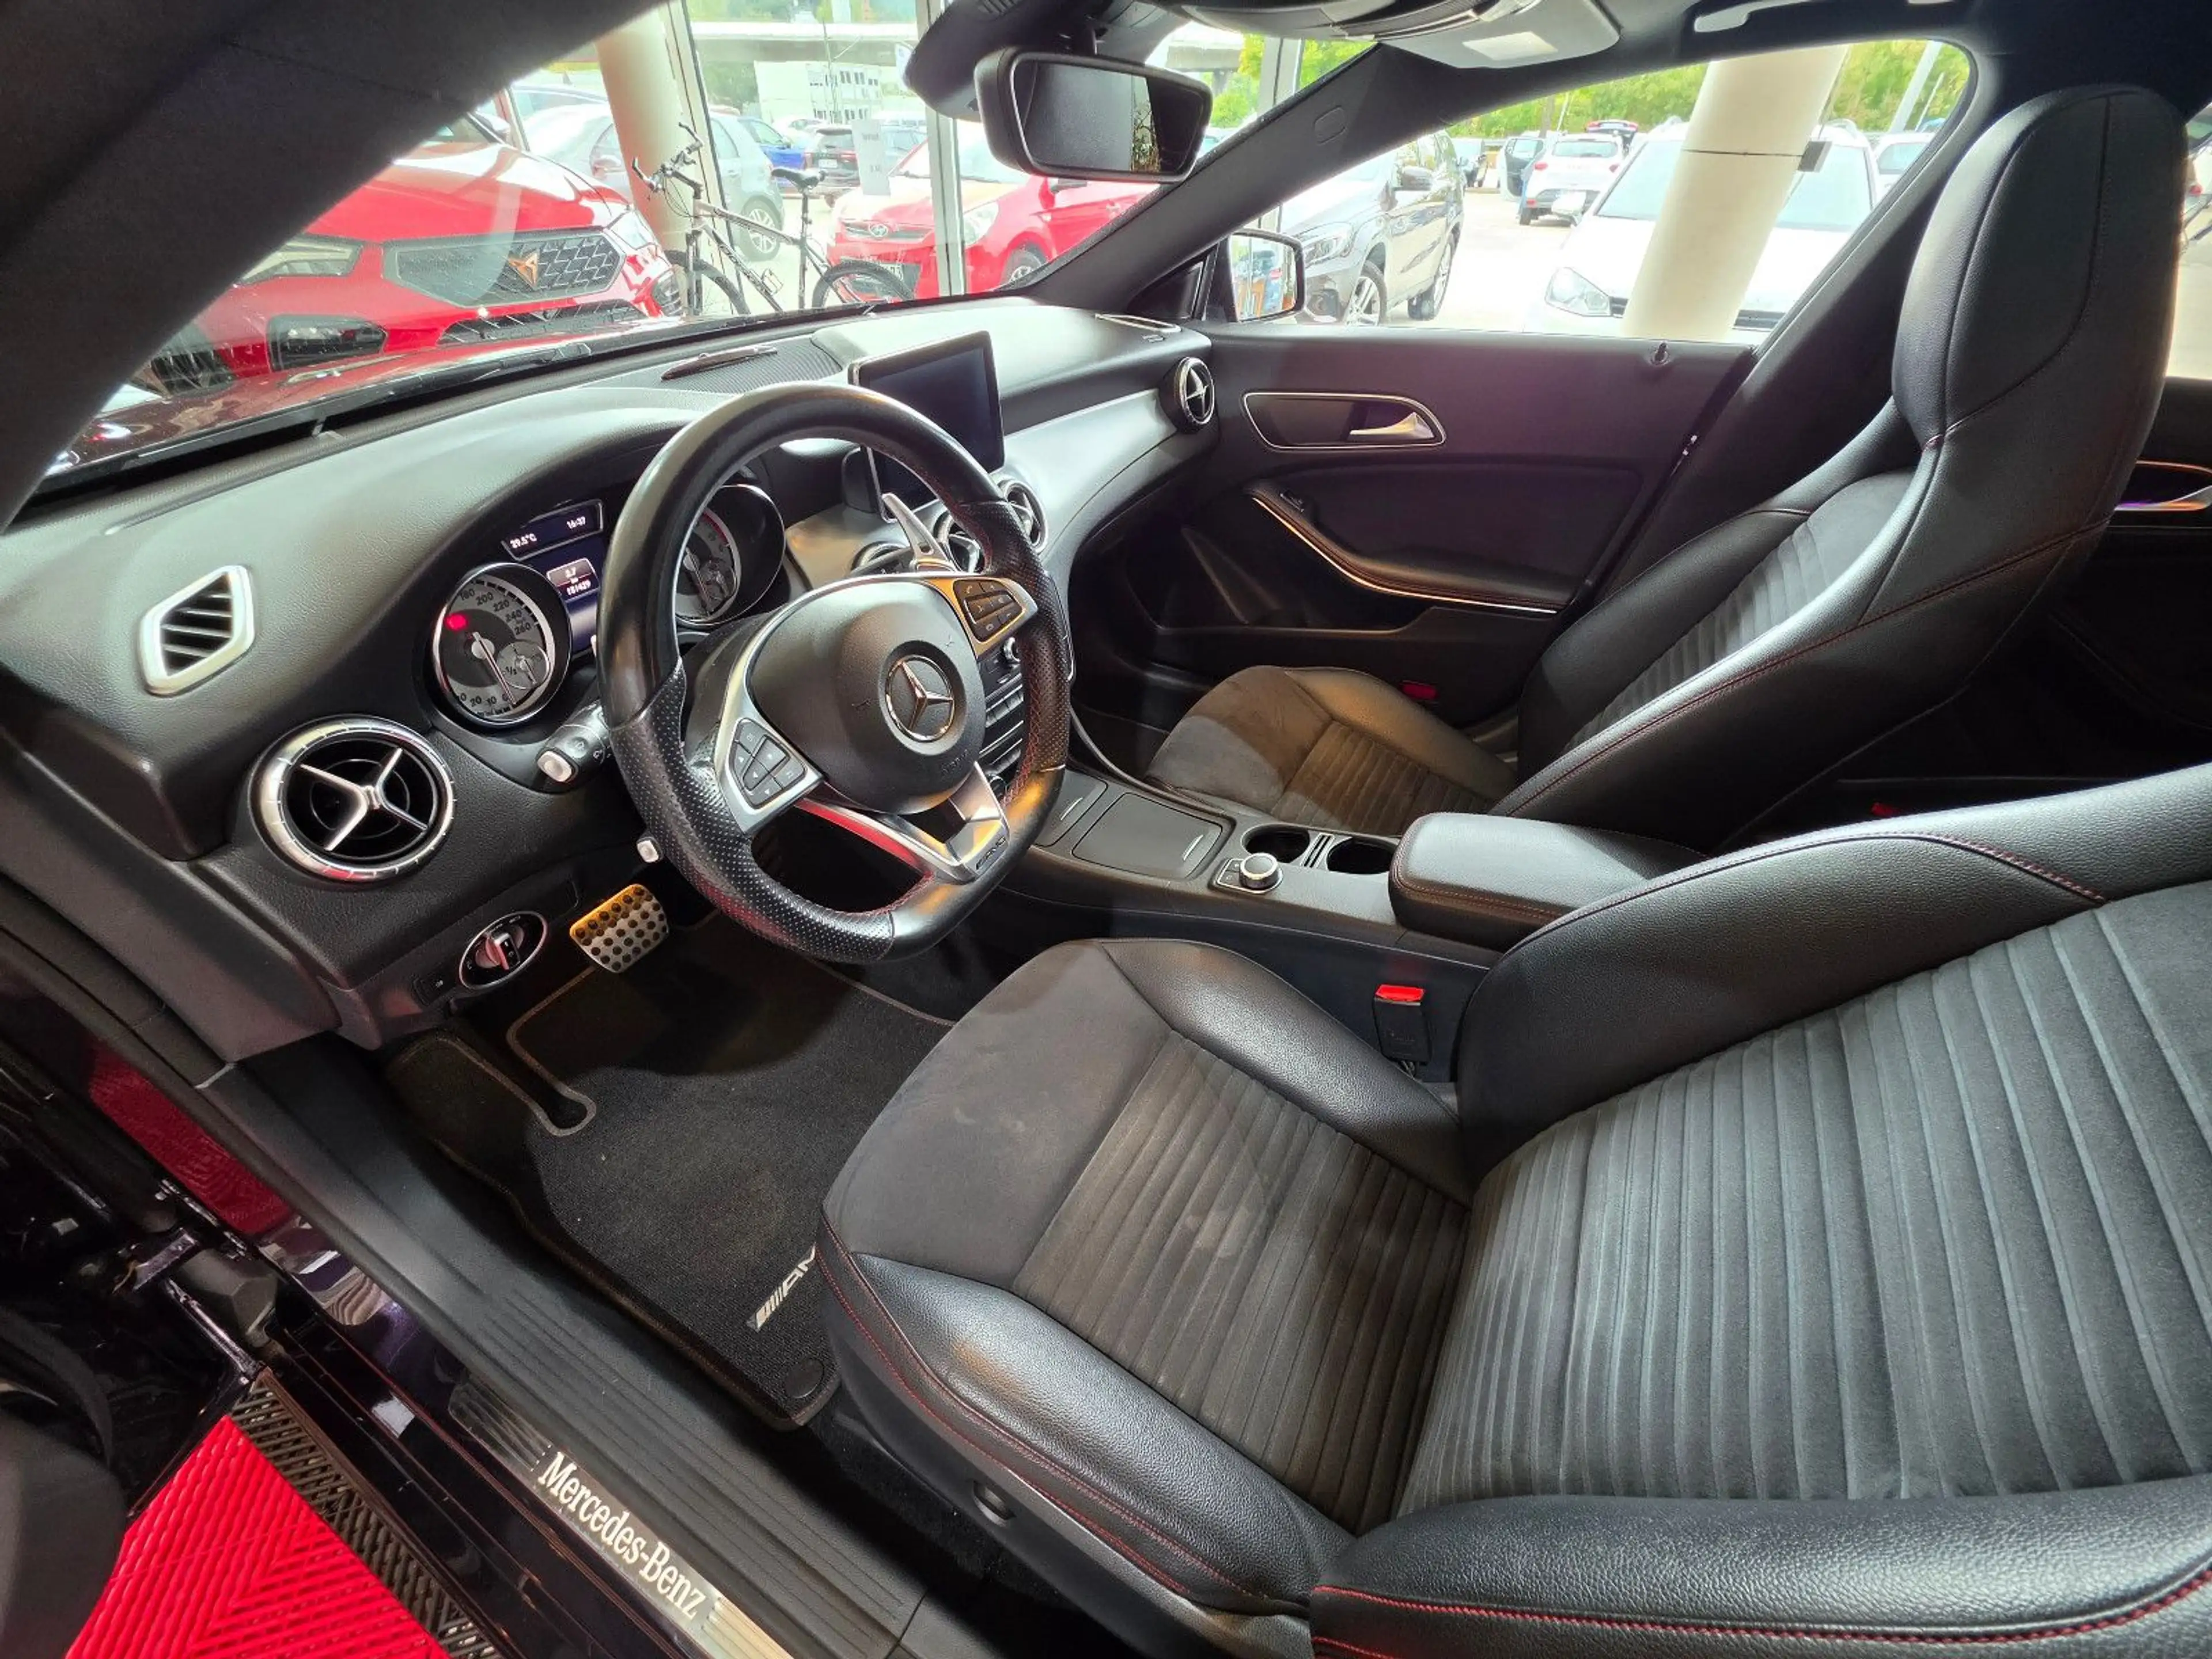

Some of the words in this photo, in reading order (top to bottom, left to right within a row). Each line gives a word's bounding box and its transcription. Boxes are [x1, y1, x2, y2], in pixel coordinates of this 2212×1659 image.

[476, 592, 494, 606] 200
[493, 599, 509, 612] 220
[505, 609, 522, 622] 240
[514, 622, 531, 635] 260
[470, 695, 482, 707] 20
[537, 1451, 706, 1620] Mercedes-Benz
